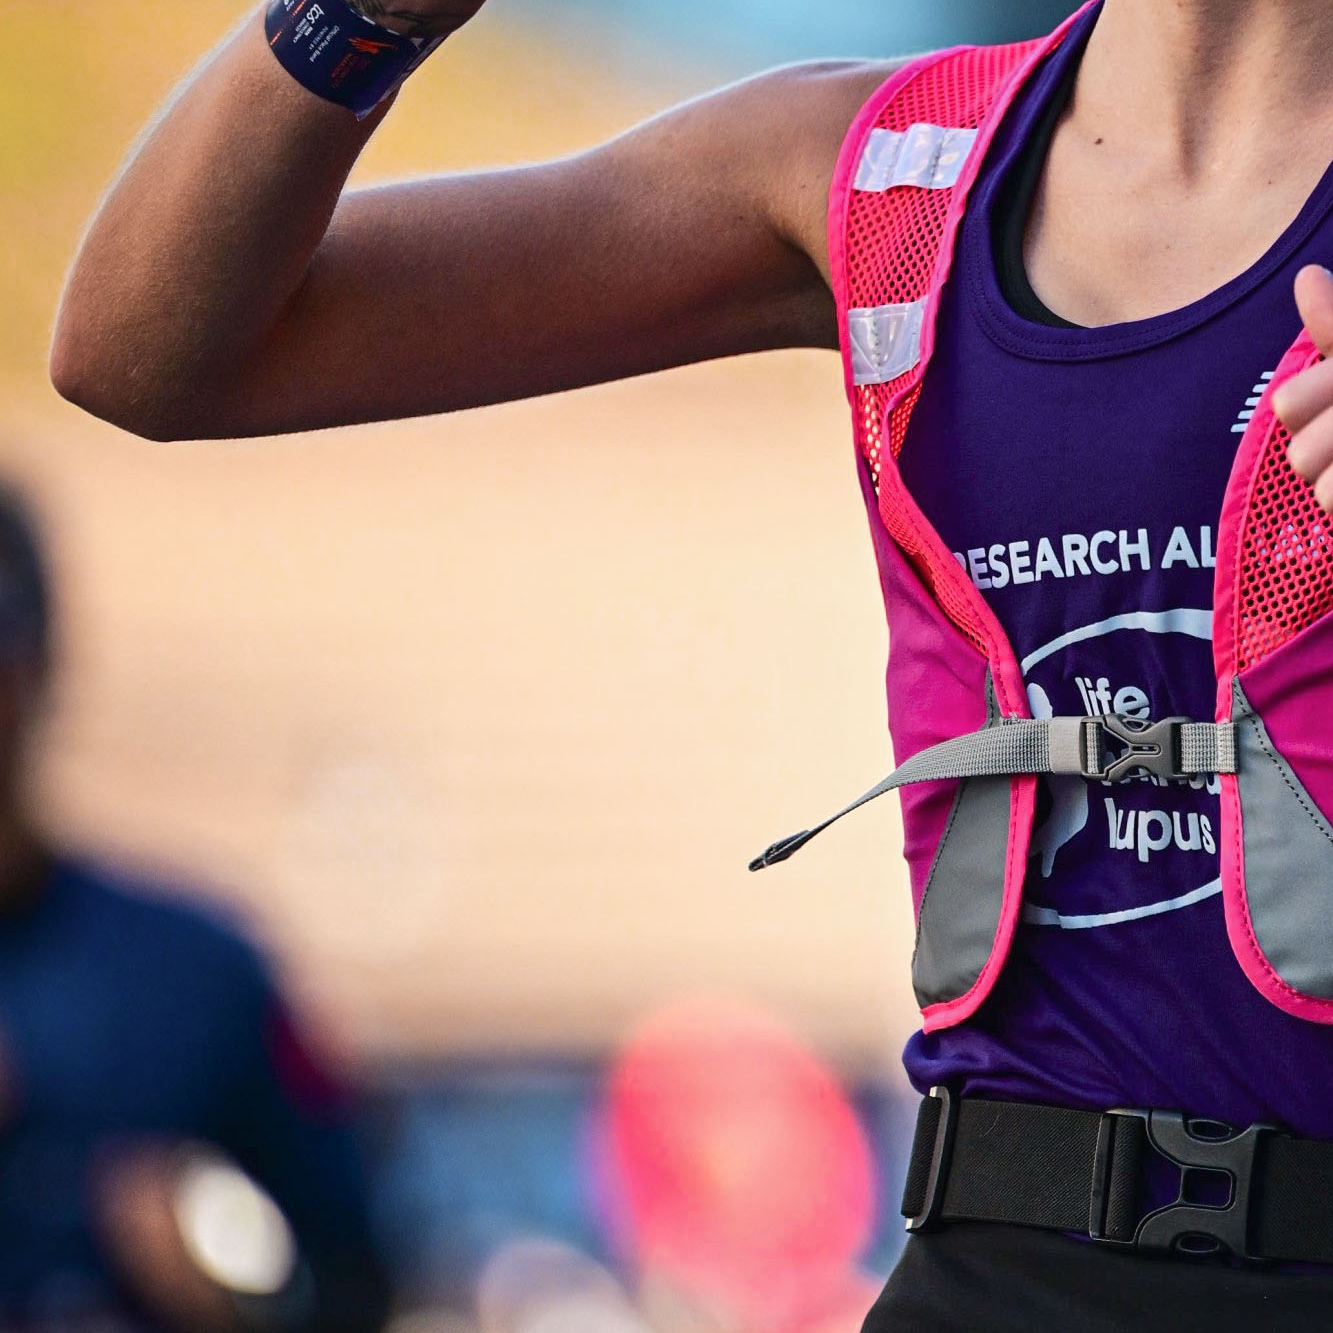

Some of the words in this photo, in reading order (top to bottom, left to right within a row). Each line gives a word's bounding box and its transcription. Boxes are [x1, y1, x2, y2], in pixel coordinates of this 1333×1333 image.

[318, 40, 329, 51] Pace
[326, 25, 340, 42] Official
[1075, 677, 1150, 719] life
[1104, 798, 1217, 862] lupus
